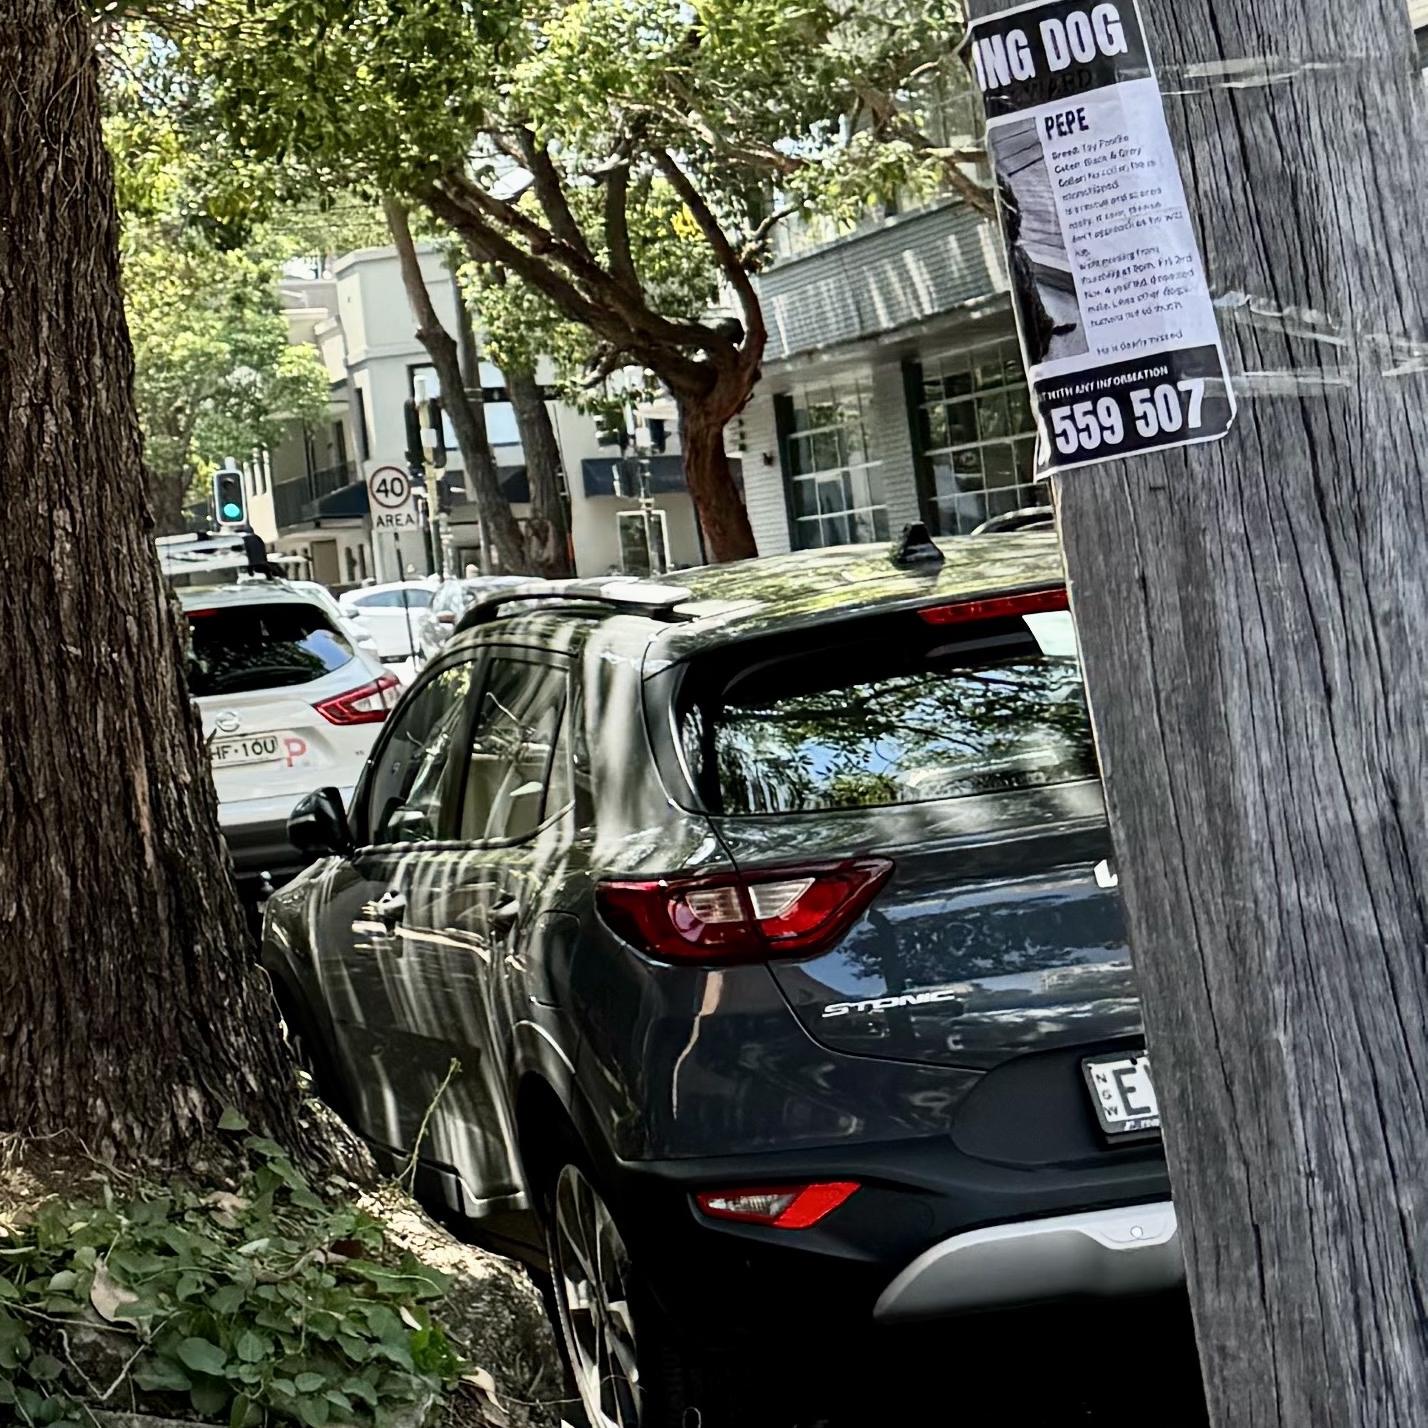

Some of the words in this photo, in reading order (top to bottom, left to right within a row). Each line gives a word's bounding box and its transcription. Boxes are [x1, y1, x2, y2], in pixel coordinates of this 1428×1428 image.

[1039, 2, 1129, 73] DOG
[1044, 106, 1090, 140] PEPE
[1096, 365, 1169, 391] INFORMATION
[1050, 396, 1125, 455] 559
[1129, 377, 1205, 438] 507
[375, 477, 404, 499] 40
[376, 513, 416, 528] AREA
[821, 989, 955, 1018] STONIC
